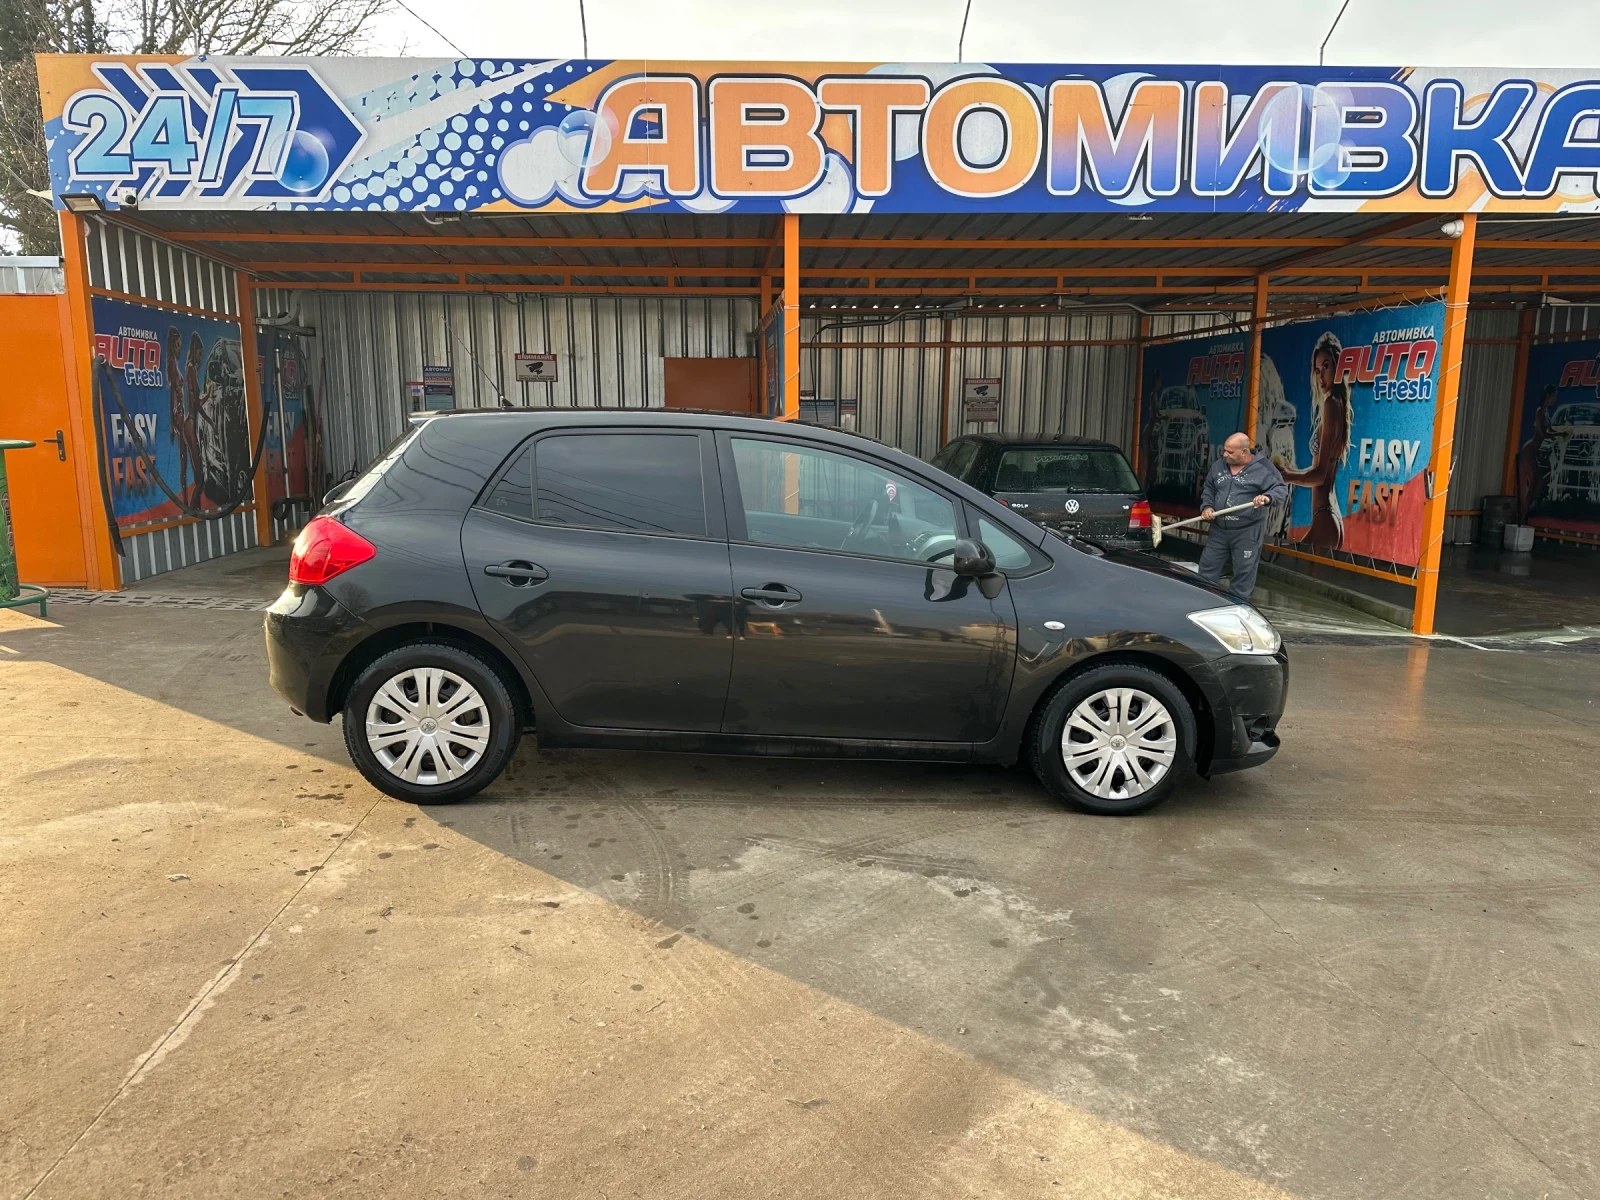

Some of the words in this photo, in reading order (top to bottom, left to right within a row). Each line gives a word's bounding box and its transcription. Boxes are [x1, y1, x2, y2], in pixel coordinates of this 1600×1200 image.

[65, 86, 299, 187] 24/7
[579, 73, 1600, 200] АВТОМИВКА
[118, 326, 158, 341] АВТОМИВКА
[1209, 342, 1244, 354] АВТОМИВКА
[1373, 325, 1434, 343] АВТОМИВКА
[95, 333, 161, 370] AUTO
[1334, 340, 1438, 384] AUTO
[124, 362, 163, 387] Fresh
[1186, 352, 1244, 385] AUTO
[1210, 378, 1242, 398] Fresh
[1373, 372, 1433, 400] Fresh
[1359, 438, 1421, 482] EASY
[1346, 479, 1404, 526] FAST
